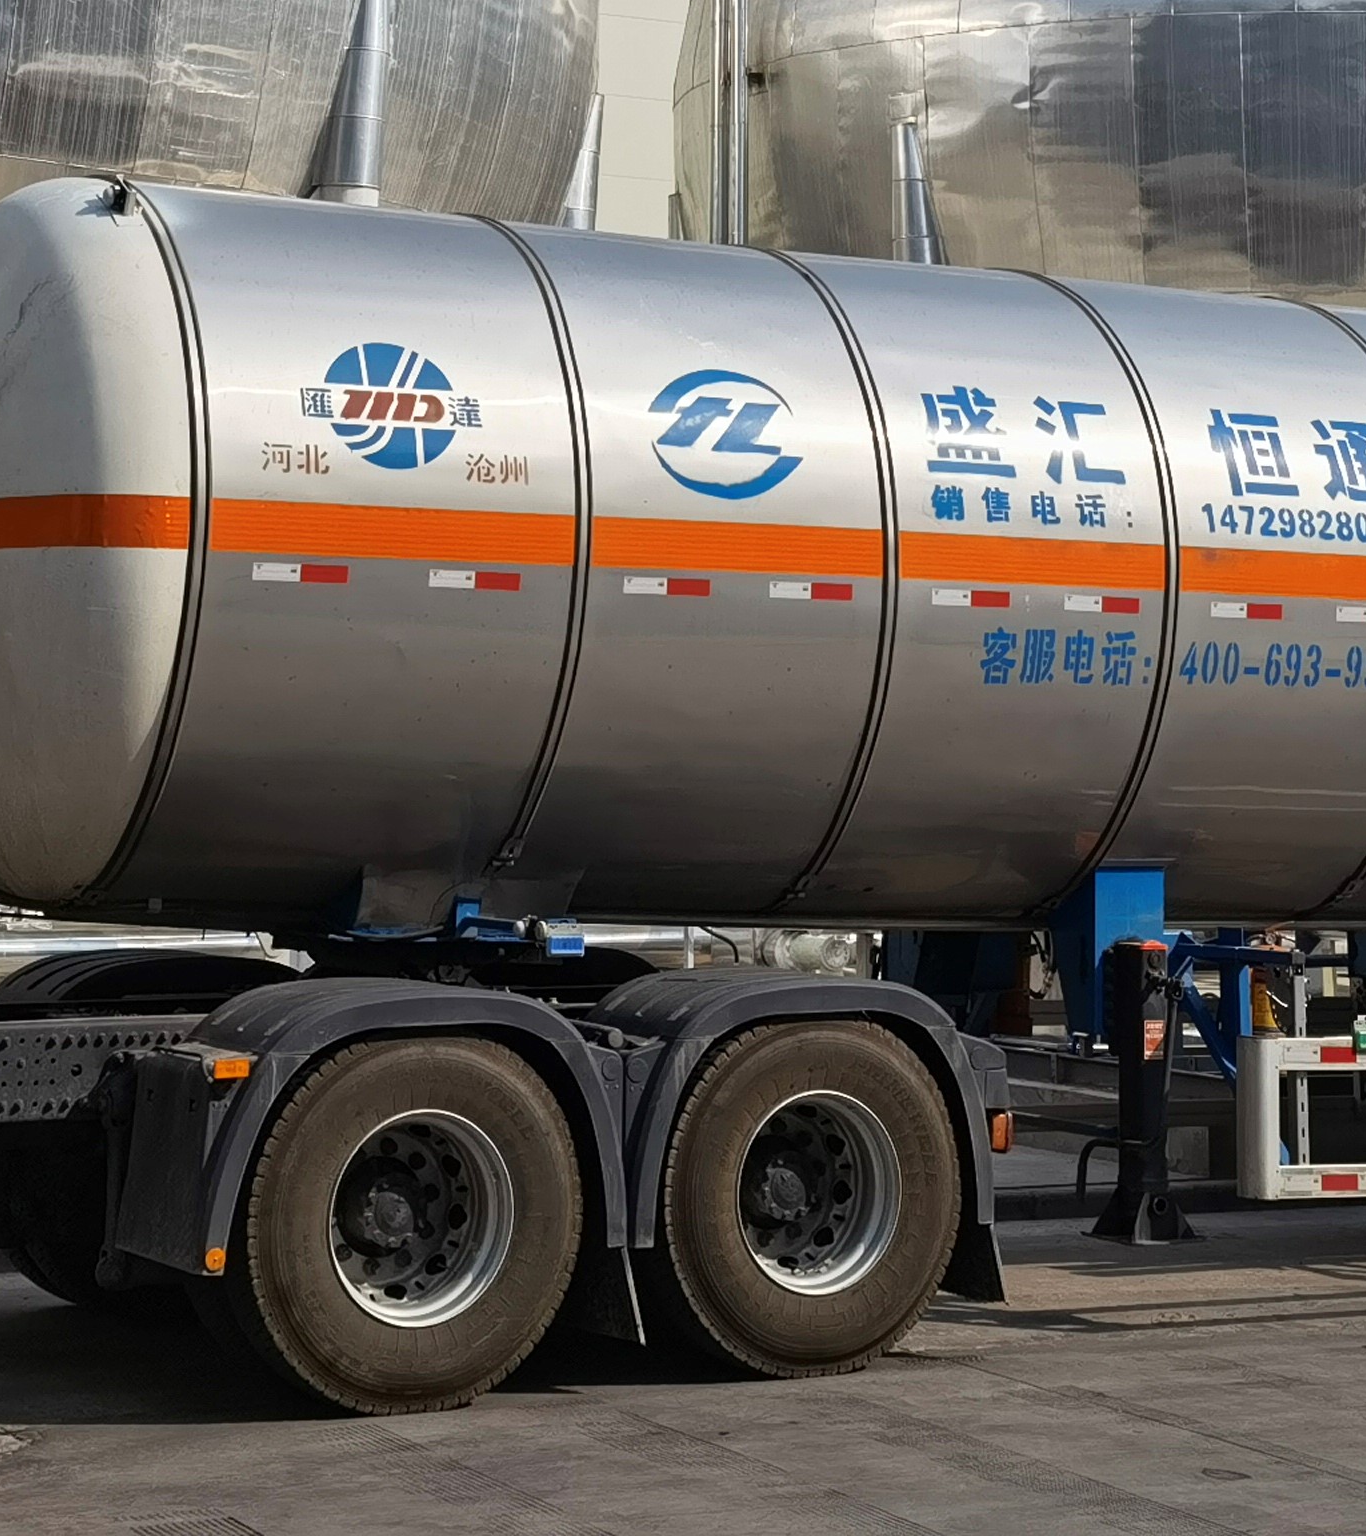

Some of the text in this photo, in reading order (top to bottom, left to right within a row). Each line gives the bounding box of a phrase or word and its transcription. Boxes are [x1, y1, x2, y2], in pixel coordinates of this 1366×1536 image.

[261, 441, 529, 486] 河北 沧州
[980, 627, 1152, 687] 客服电话：
